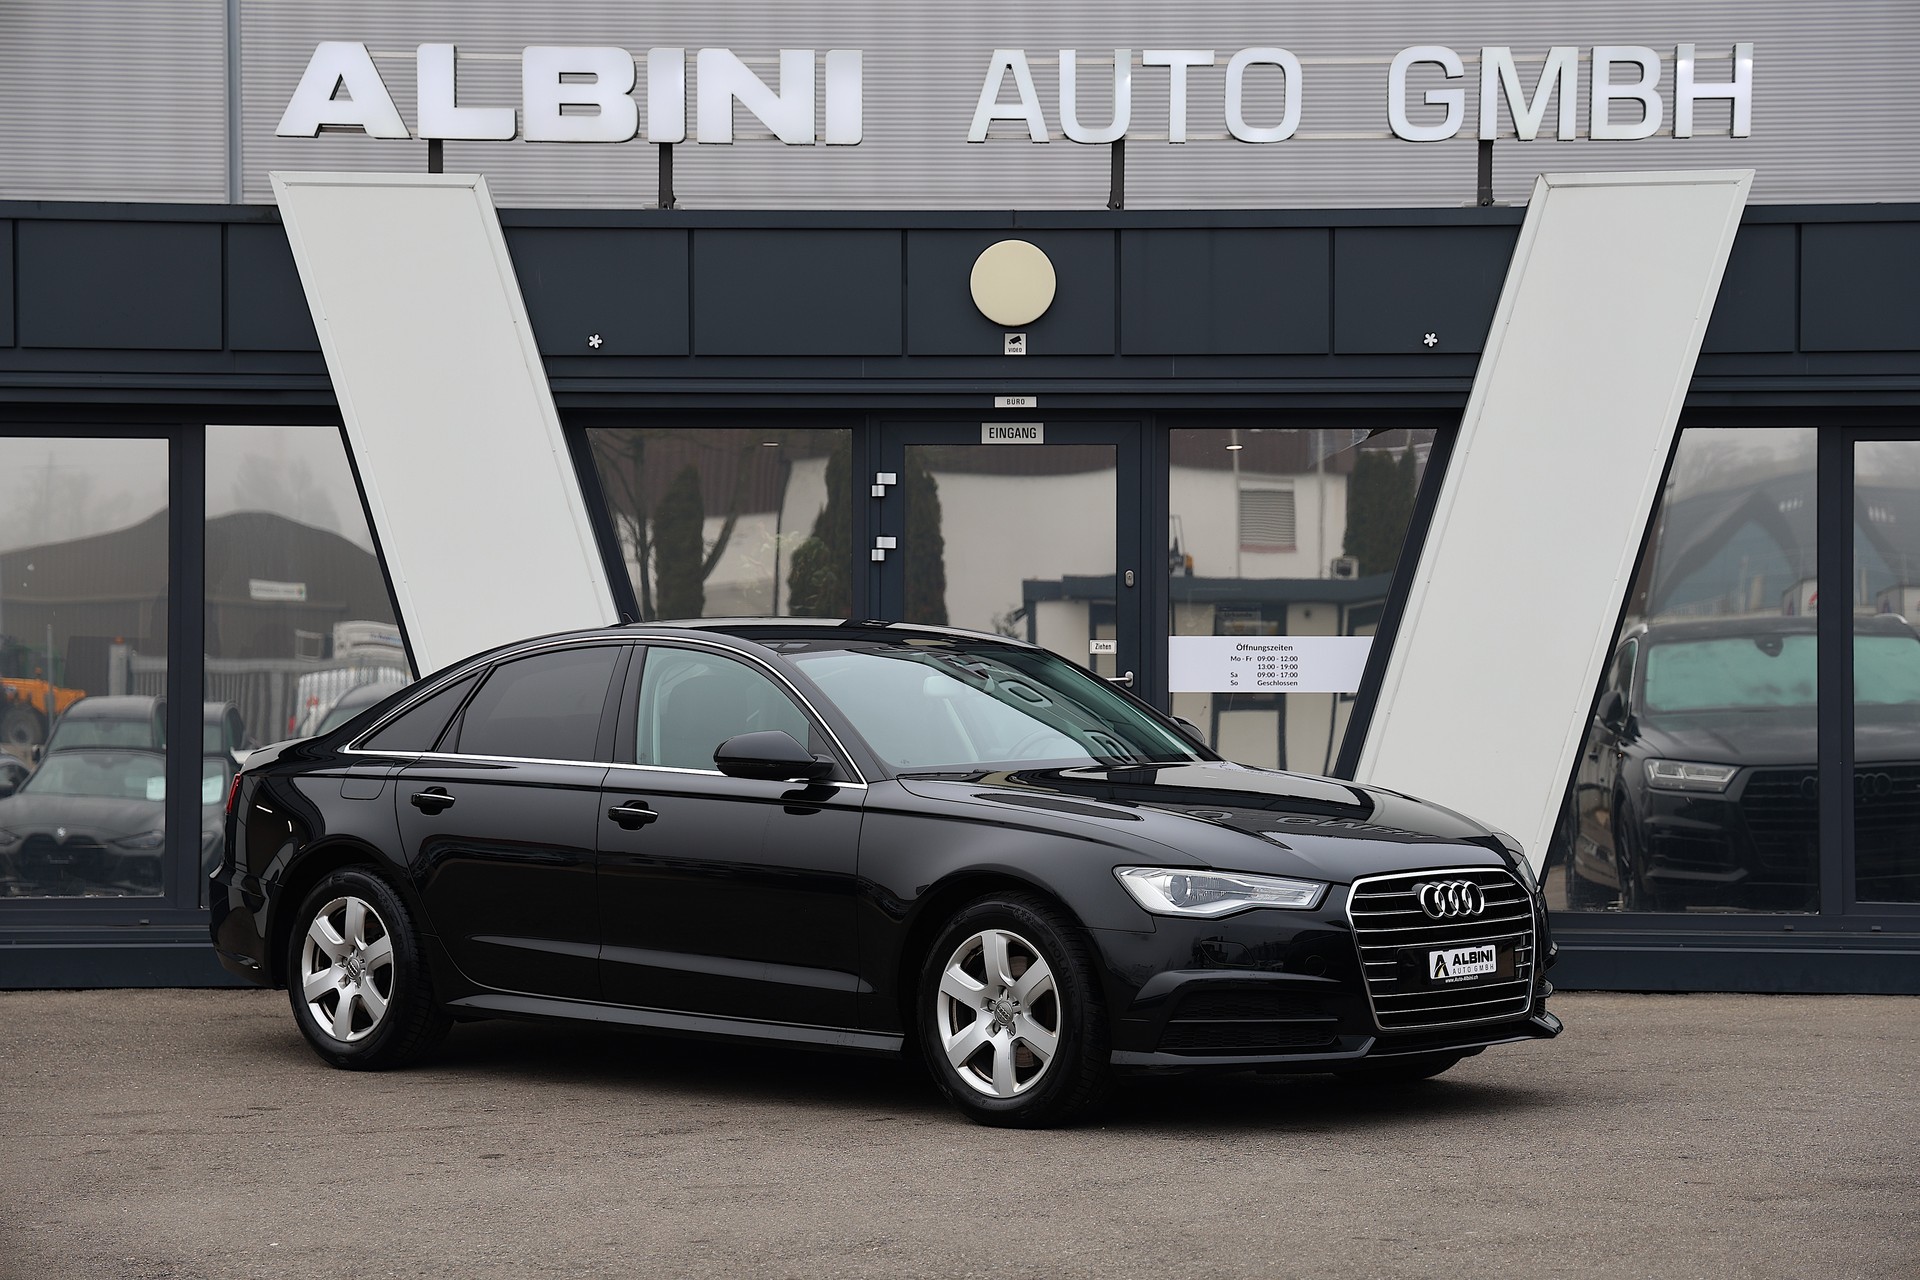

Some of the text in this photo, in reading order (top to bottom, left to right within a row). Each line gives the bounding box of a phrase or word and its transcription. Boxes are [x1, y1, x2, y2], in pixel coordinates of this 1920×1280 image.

[275, 41, 1754, 145] ALBINI AUTO GMBH
[1006, 397, 1026, 405] BÜRO
[989, 427, 1037, 439] EINGANG
[1095, 642, 1112, 650] Ziehen
[1236, 643, 1293, 652] Öffnungszeiten
[1453, 950, 1493, 966] ALBINI
[1453, 966, 1471, 974] AUTO
